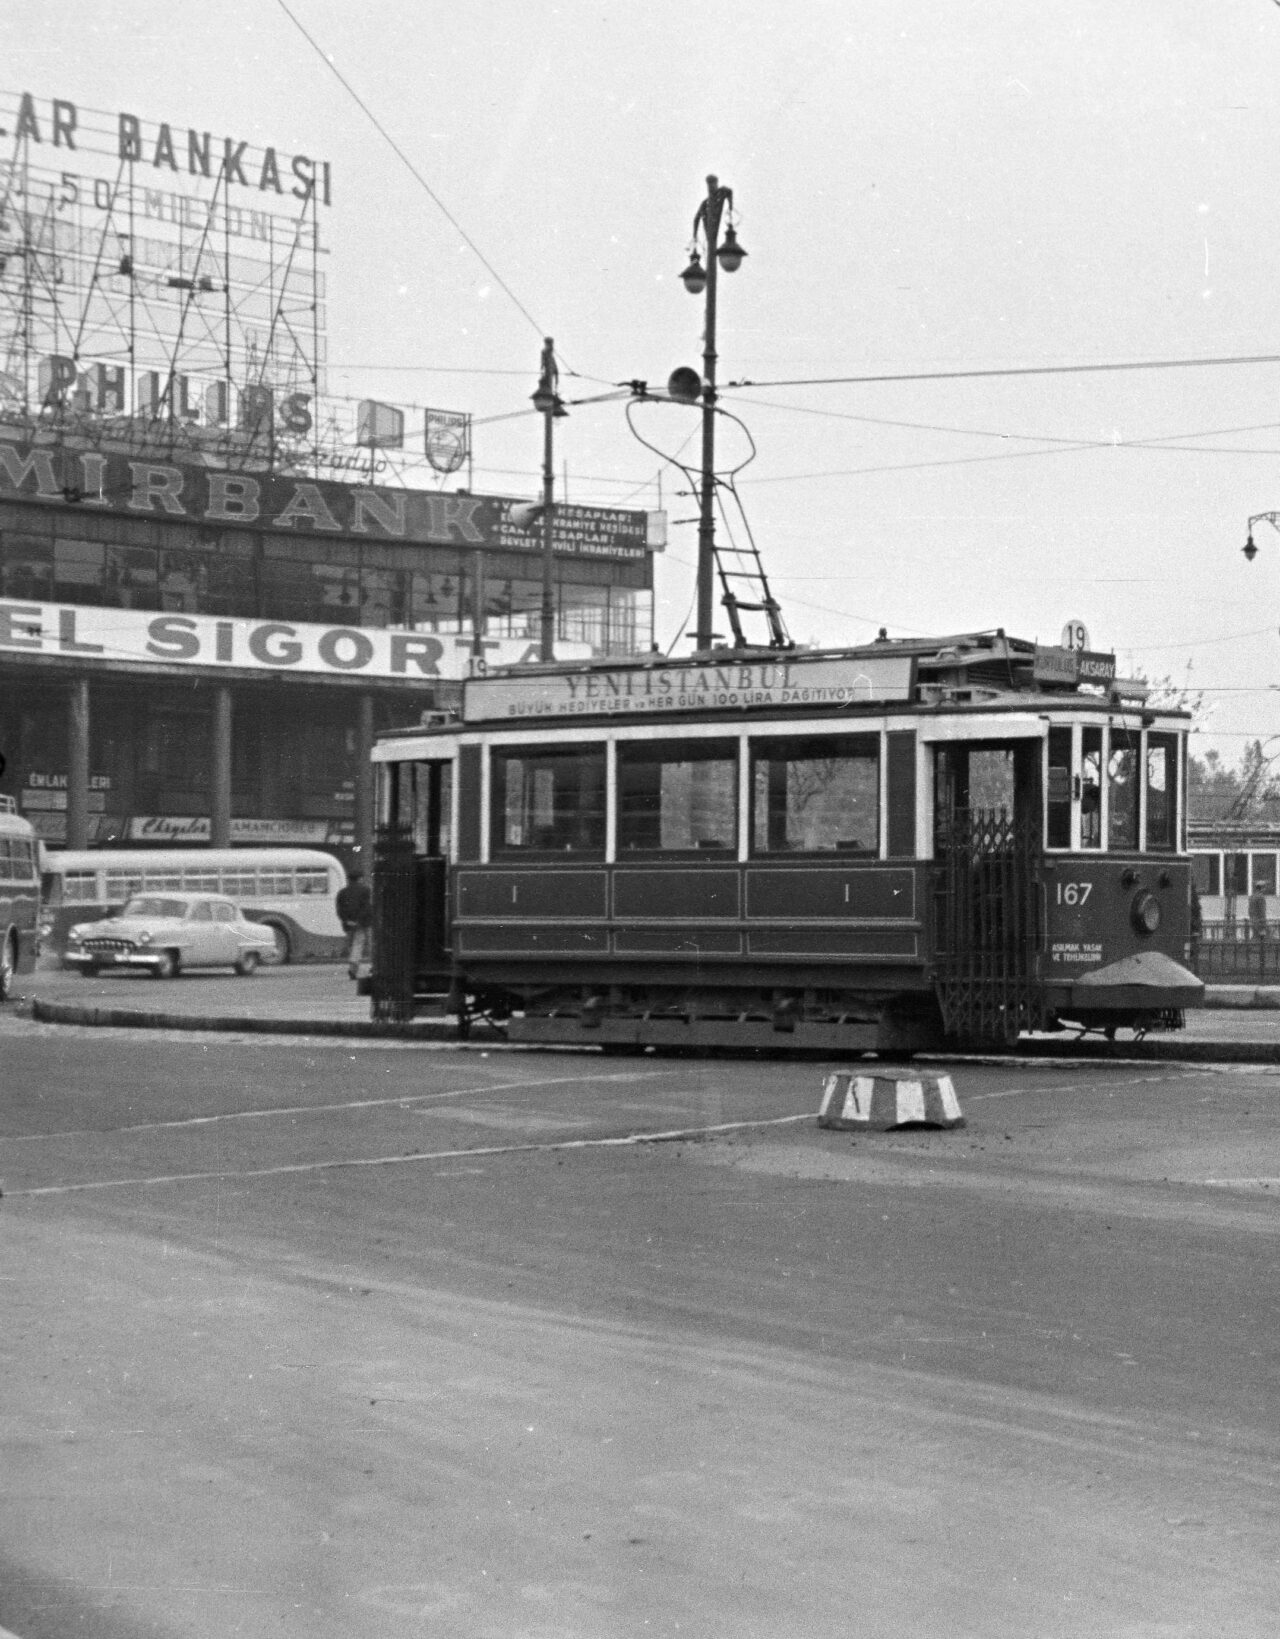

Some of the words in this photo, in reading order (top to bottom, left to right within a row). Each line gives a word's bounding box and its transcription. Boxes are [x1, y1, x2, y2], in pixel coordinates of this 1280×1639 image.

[0, 92, 76, 150] AR
[118, 112, 332, 206] BANKASI
[39, 354, 313, 432] PHILIPS
[1068, 625, 1085, 650] 19
[650, 698, 674, 708] HER
[713, 692, 738, 705] 100
[1056, 883, 1093, 905] 167
